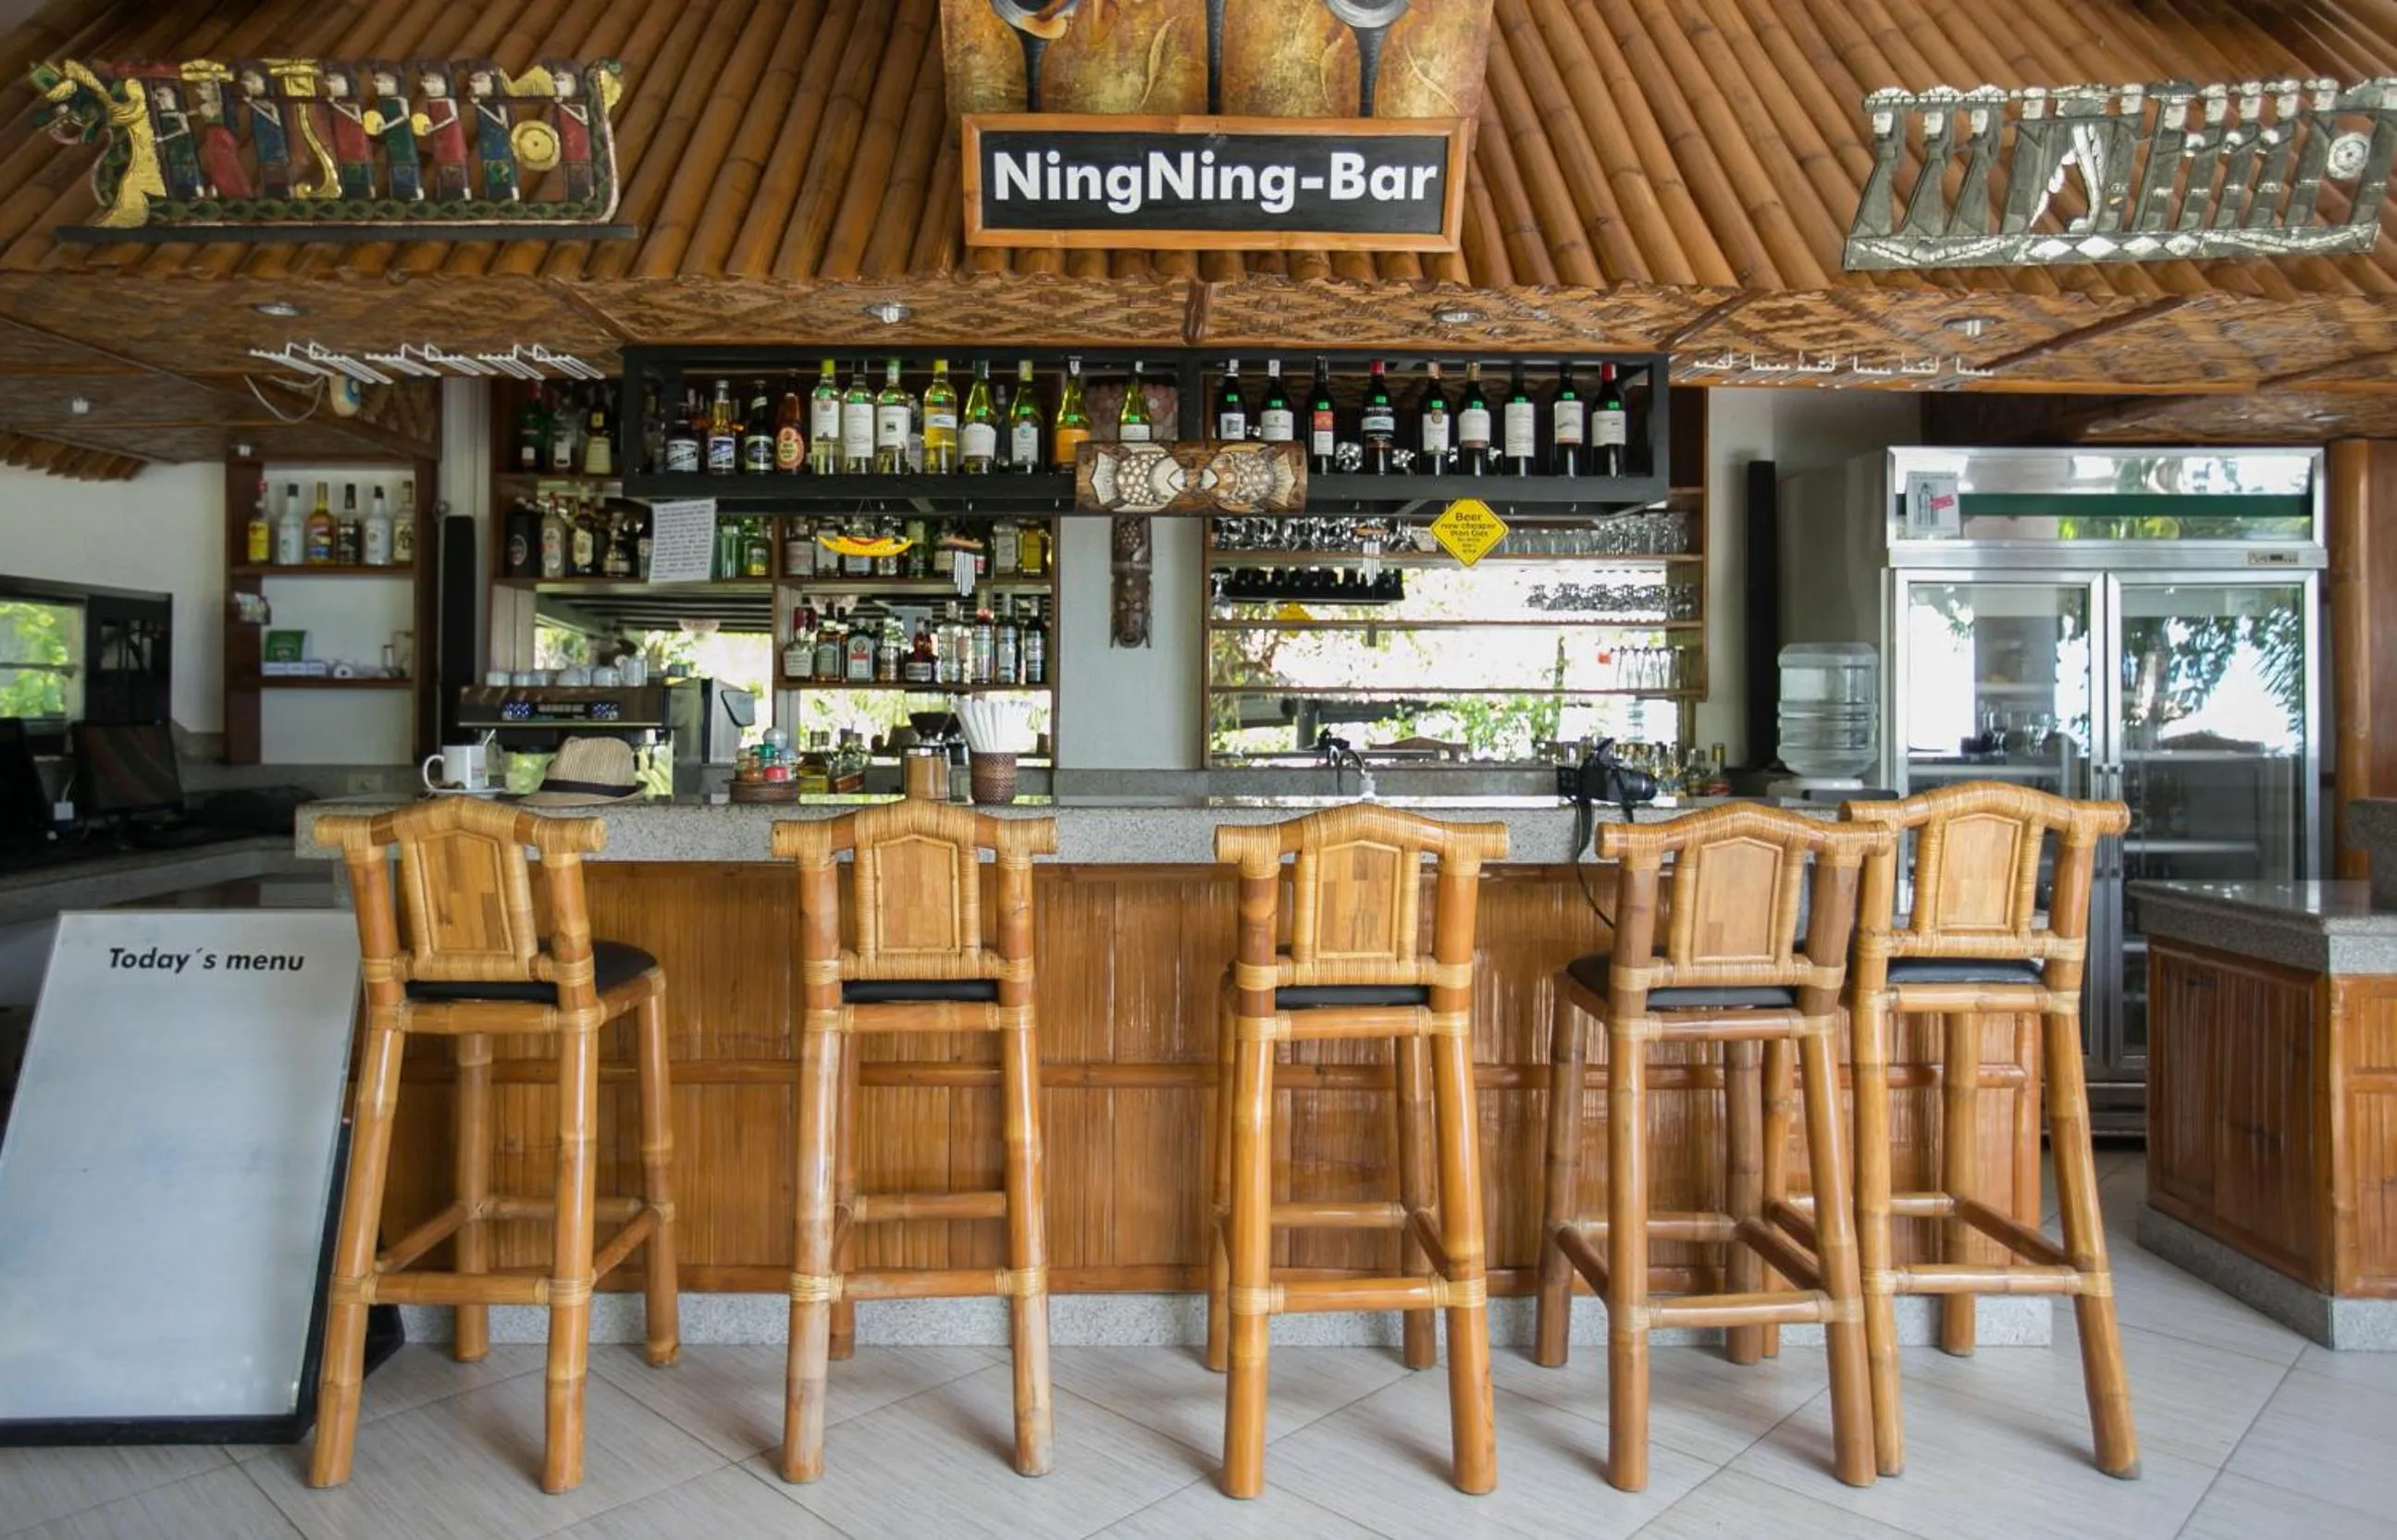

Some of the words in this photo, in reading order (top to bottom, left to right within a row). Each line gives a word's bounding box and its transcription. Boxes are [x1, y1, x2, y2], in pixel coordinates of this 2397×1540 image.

[993, 149, 1437, 214] NingNing-Bar
[1455, 512, 1482, 521] Beer
[226, 954, 305, 971] menu
